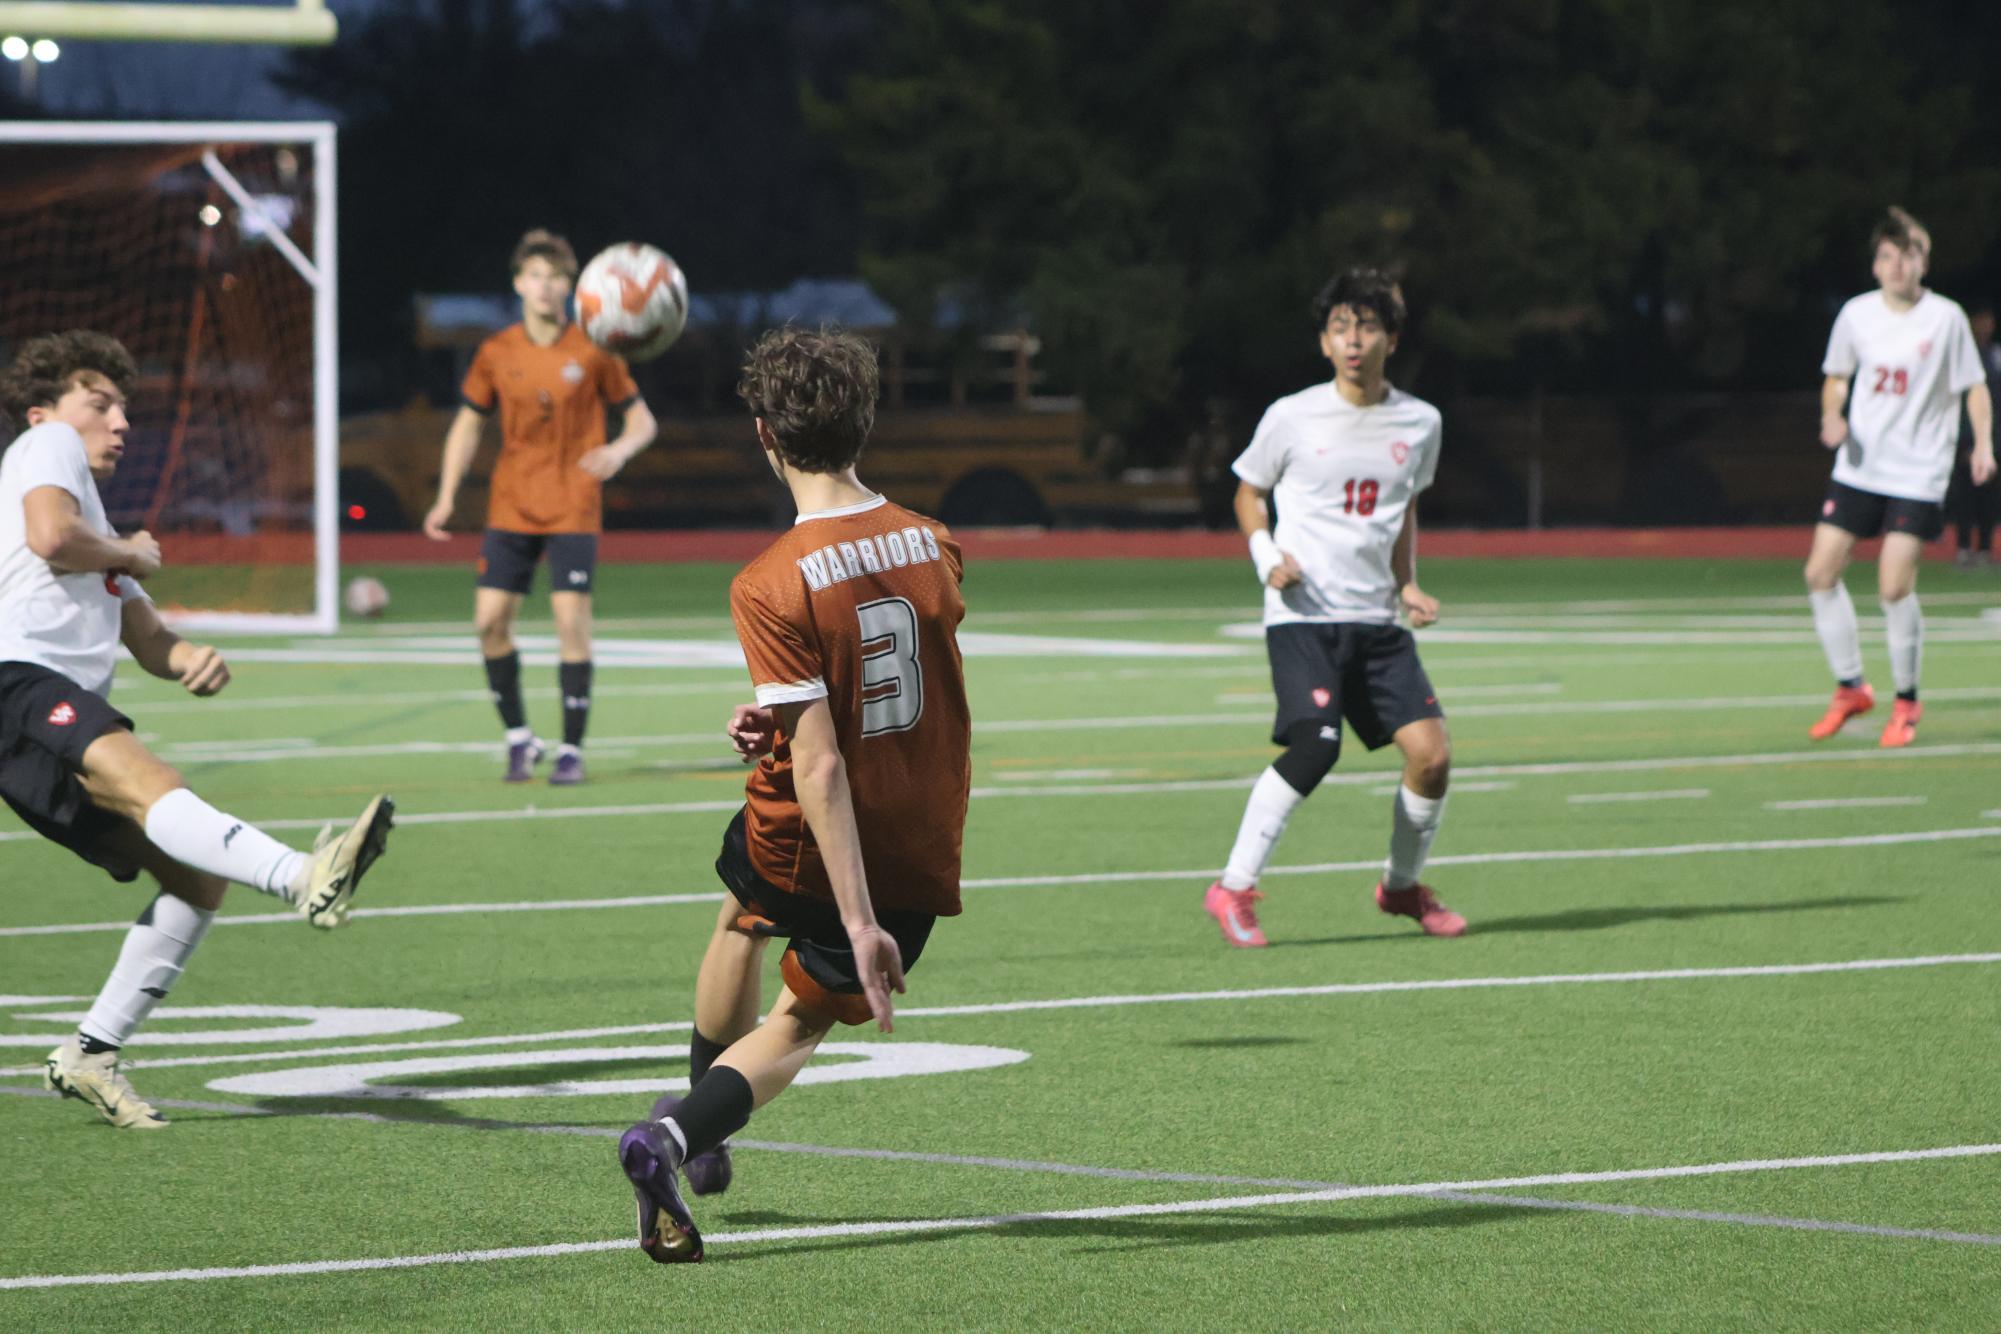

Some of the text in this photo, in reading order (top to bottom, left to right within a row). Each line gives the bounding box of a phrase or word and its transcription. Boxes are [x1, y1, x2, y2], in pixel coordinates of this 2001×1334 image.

[1344, 478, 1380, 516] 18
[797, 526, 941, 591] WARRIORS
[856, 596, 924, 738] 3
